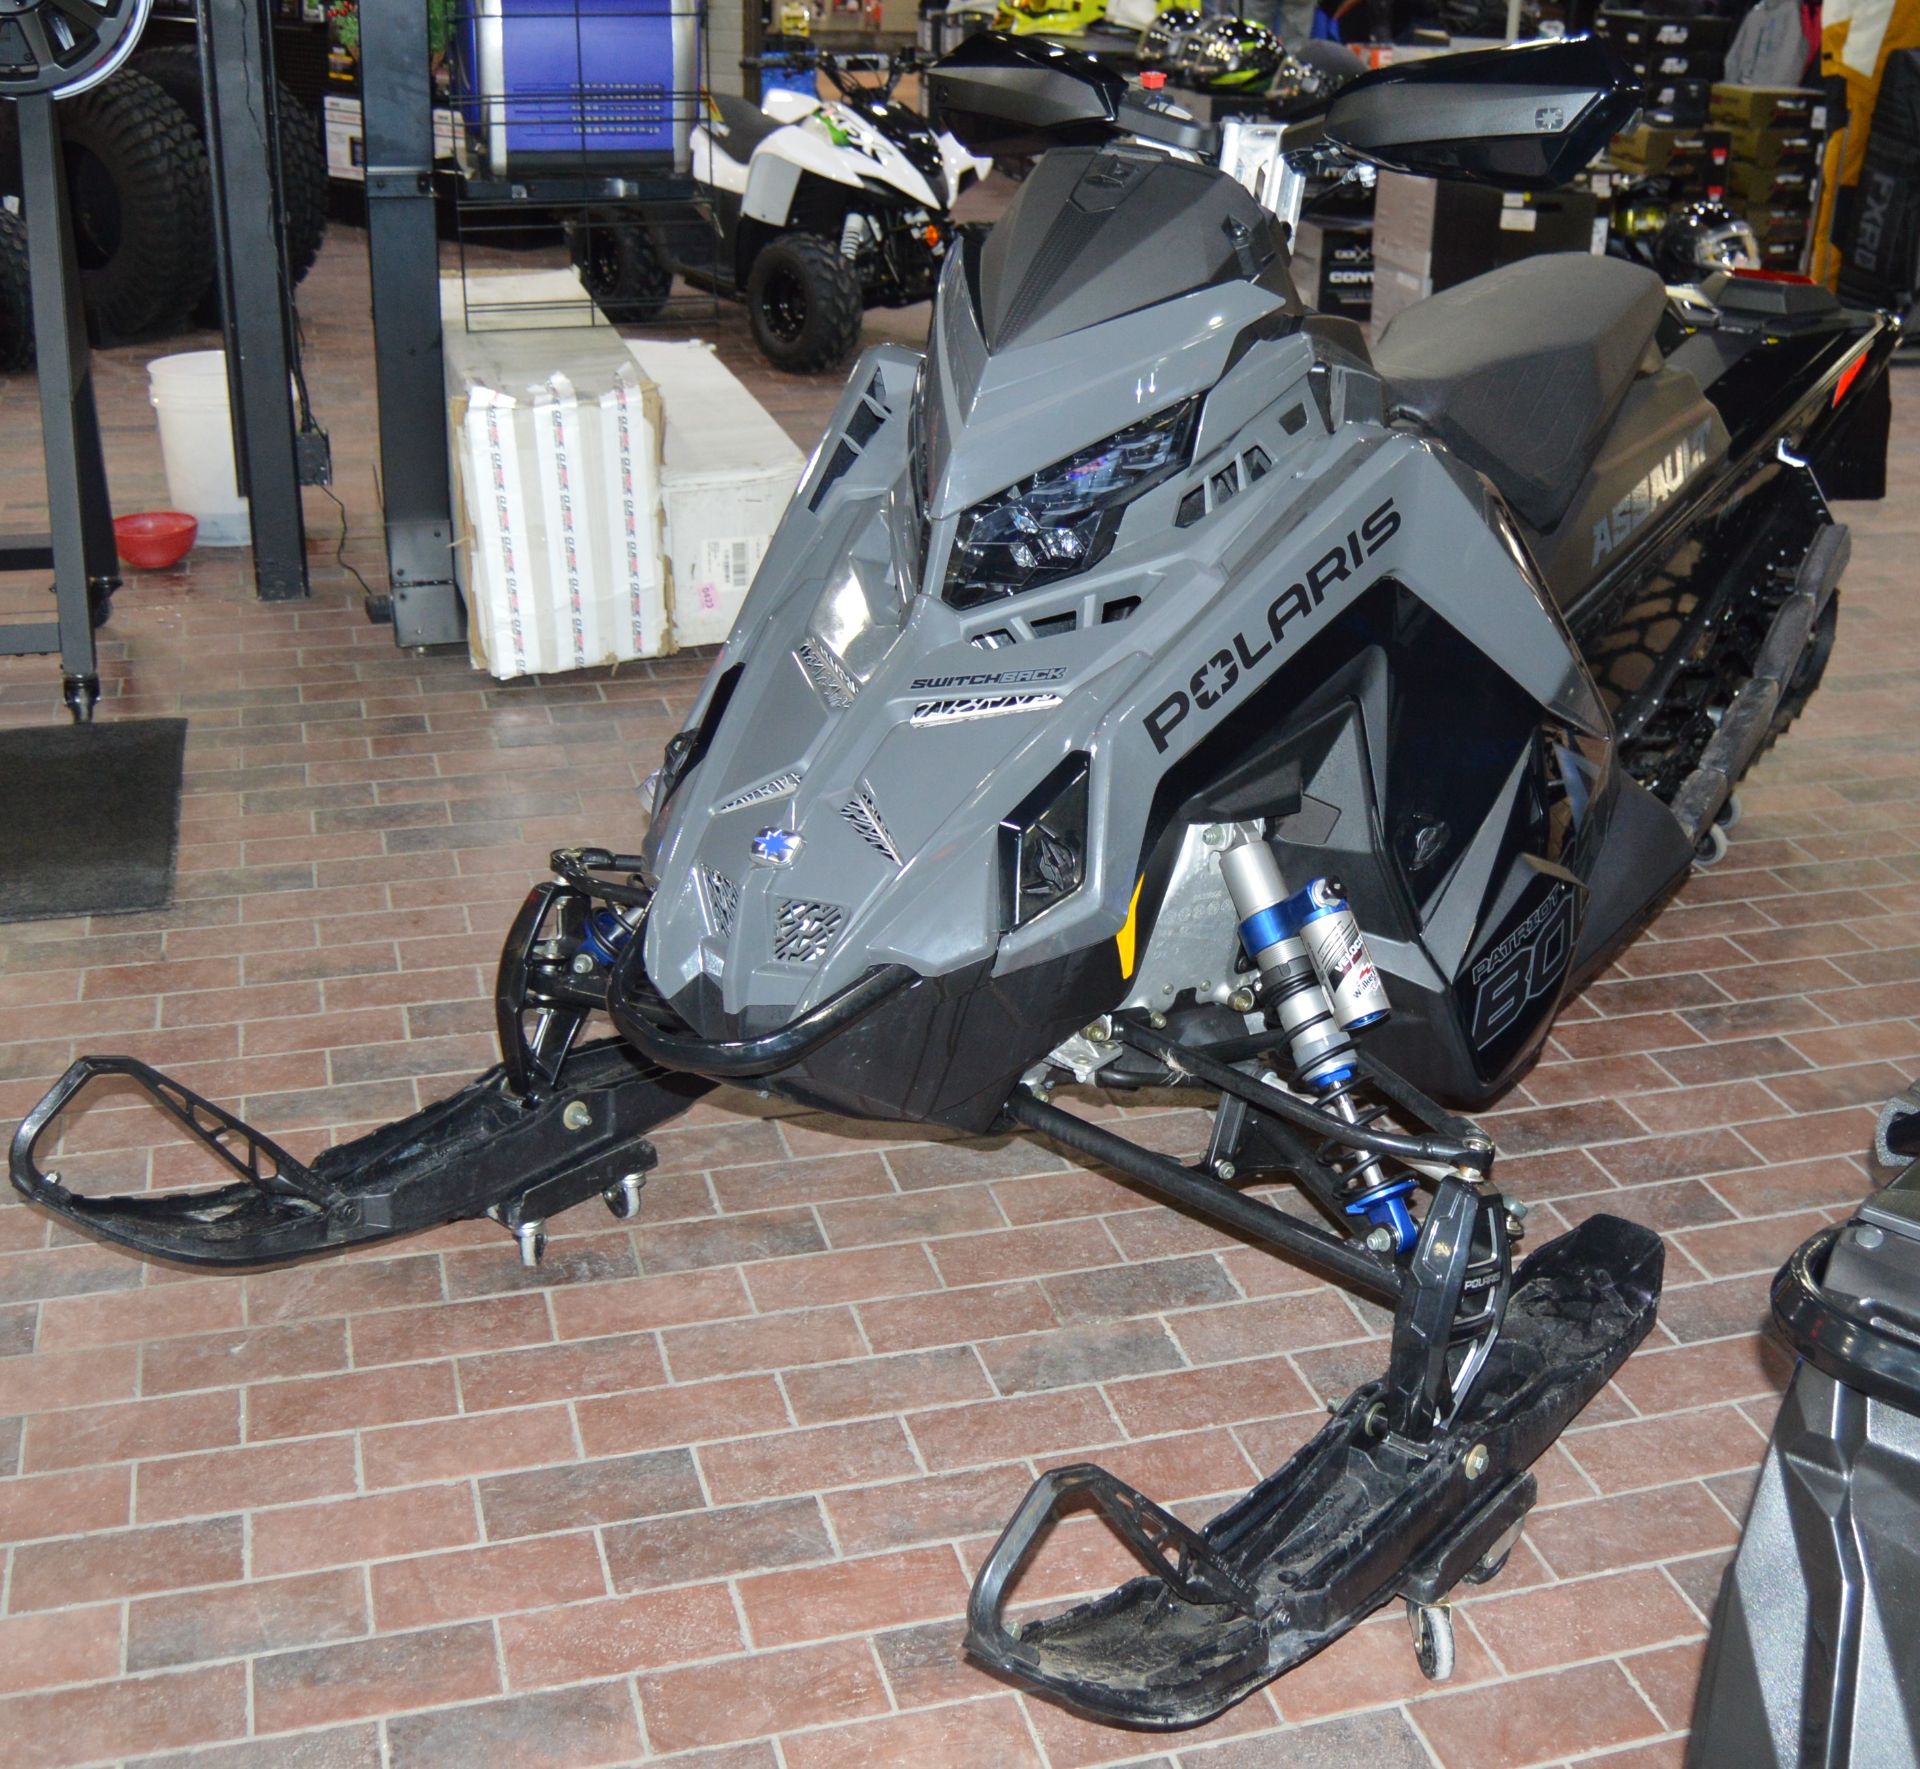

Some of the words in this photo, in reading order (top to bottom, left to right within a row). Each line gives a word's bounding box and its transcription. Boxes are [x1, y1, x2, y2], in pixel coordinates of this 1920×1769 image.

[910, 667, 1066, 690] SWITCHBACK
[1142, 497, 1401, 755] POLARIS
[1472, 881, 1563, 986] PATRIOT
